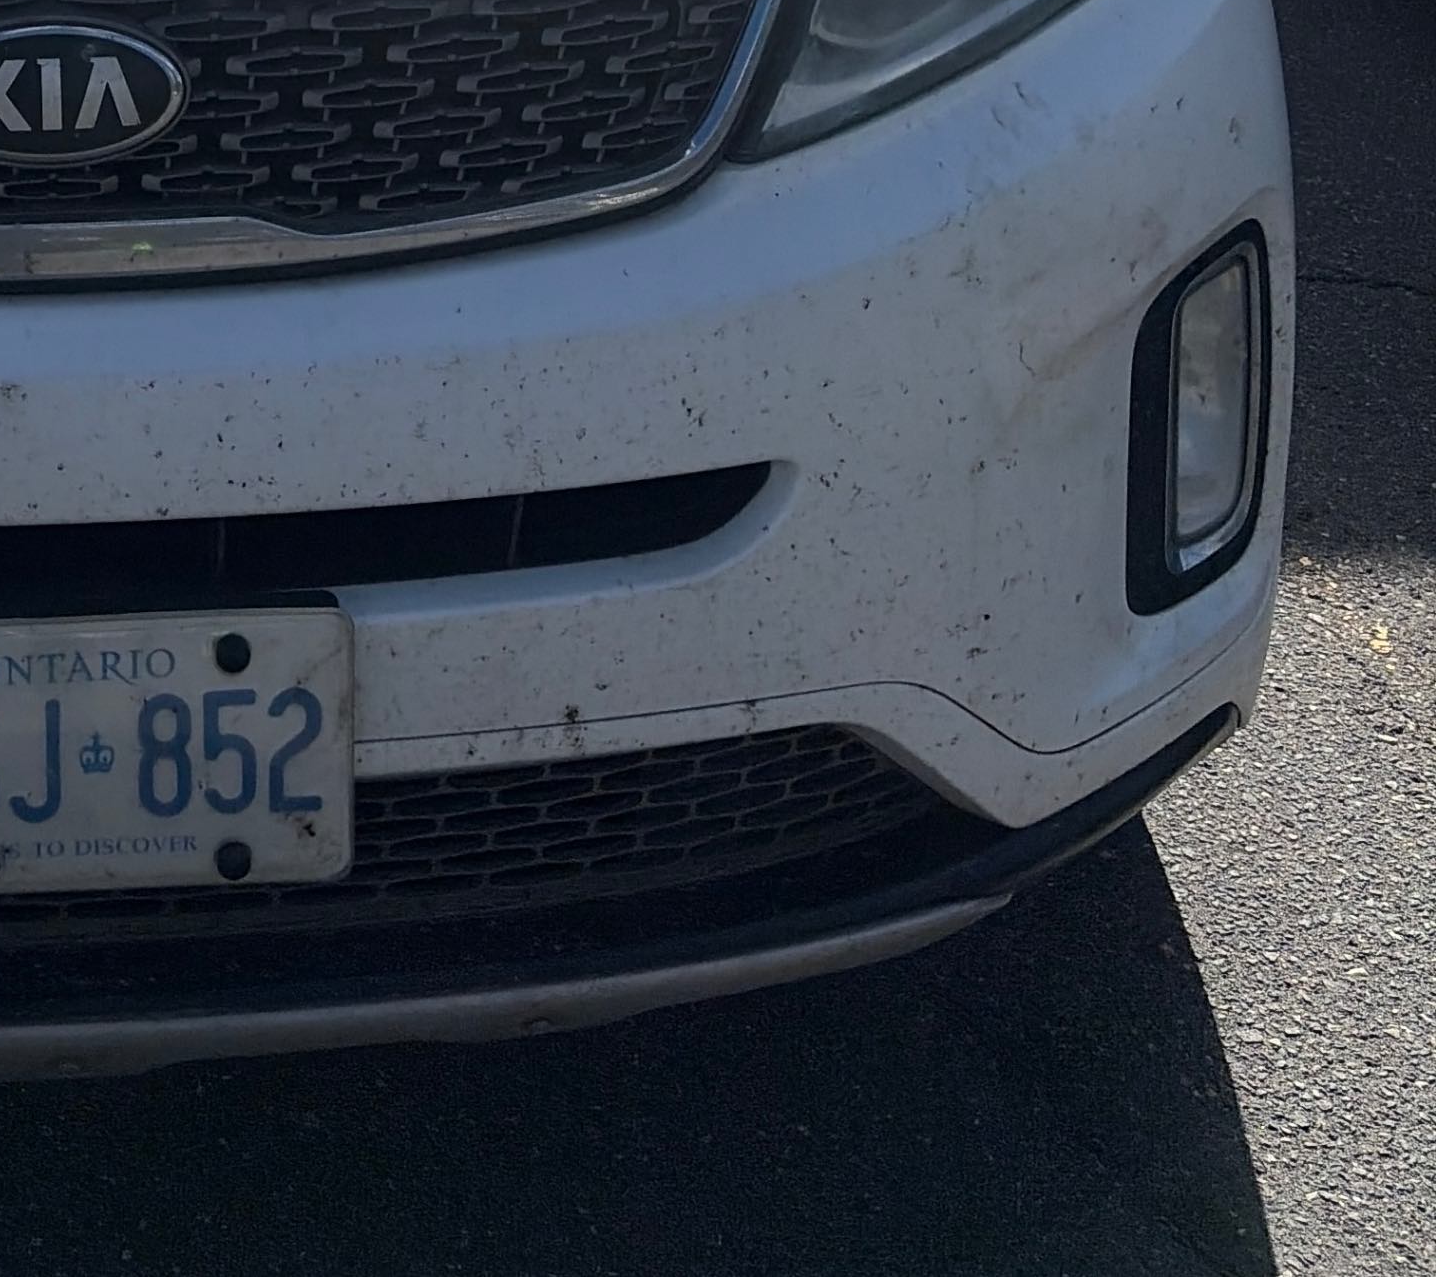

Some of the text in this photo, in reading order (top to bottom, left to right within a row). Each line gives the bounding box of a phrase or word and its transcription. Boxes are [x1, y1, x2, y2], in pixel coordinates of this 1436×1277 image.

[137, 686, 323, 817] 852
[34, 841, 65, 858] TO
[75, 835, 198, 857] DISCOVER
